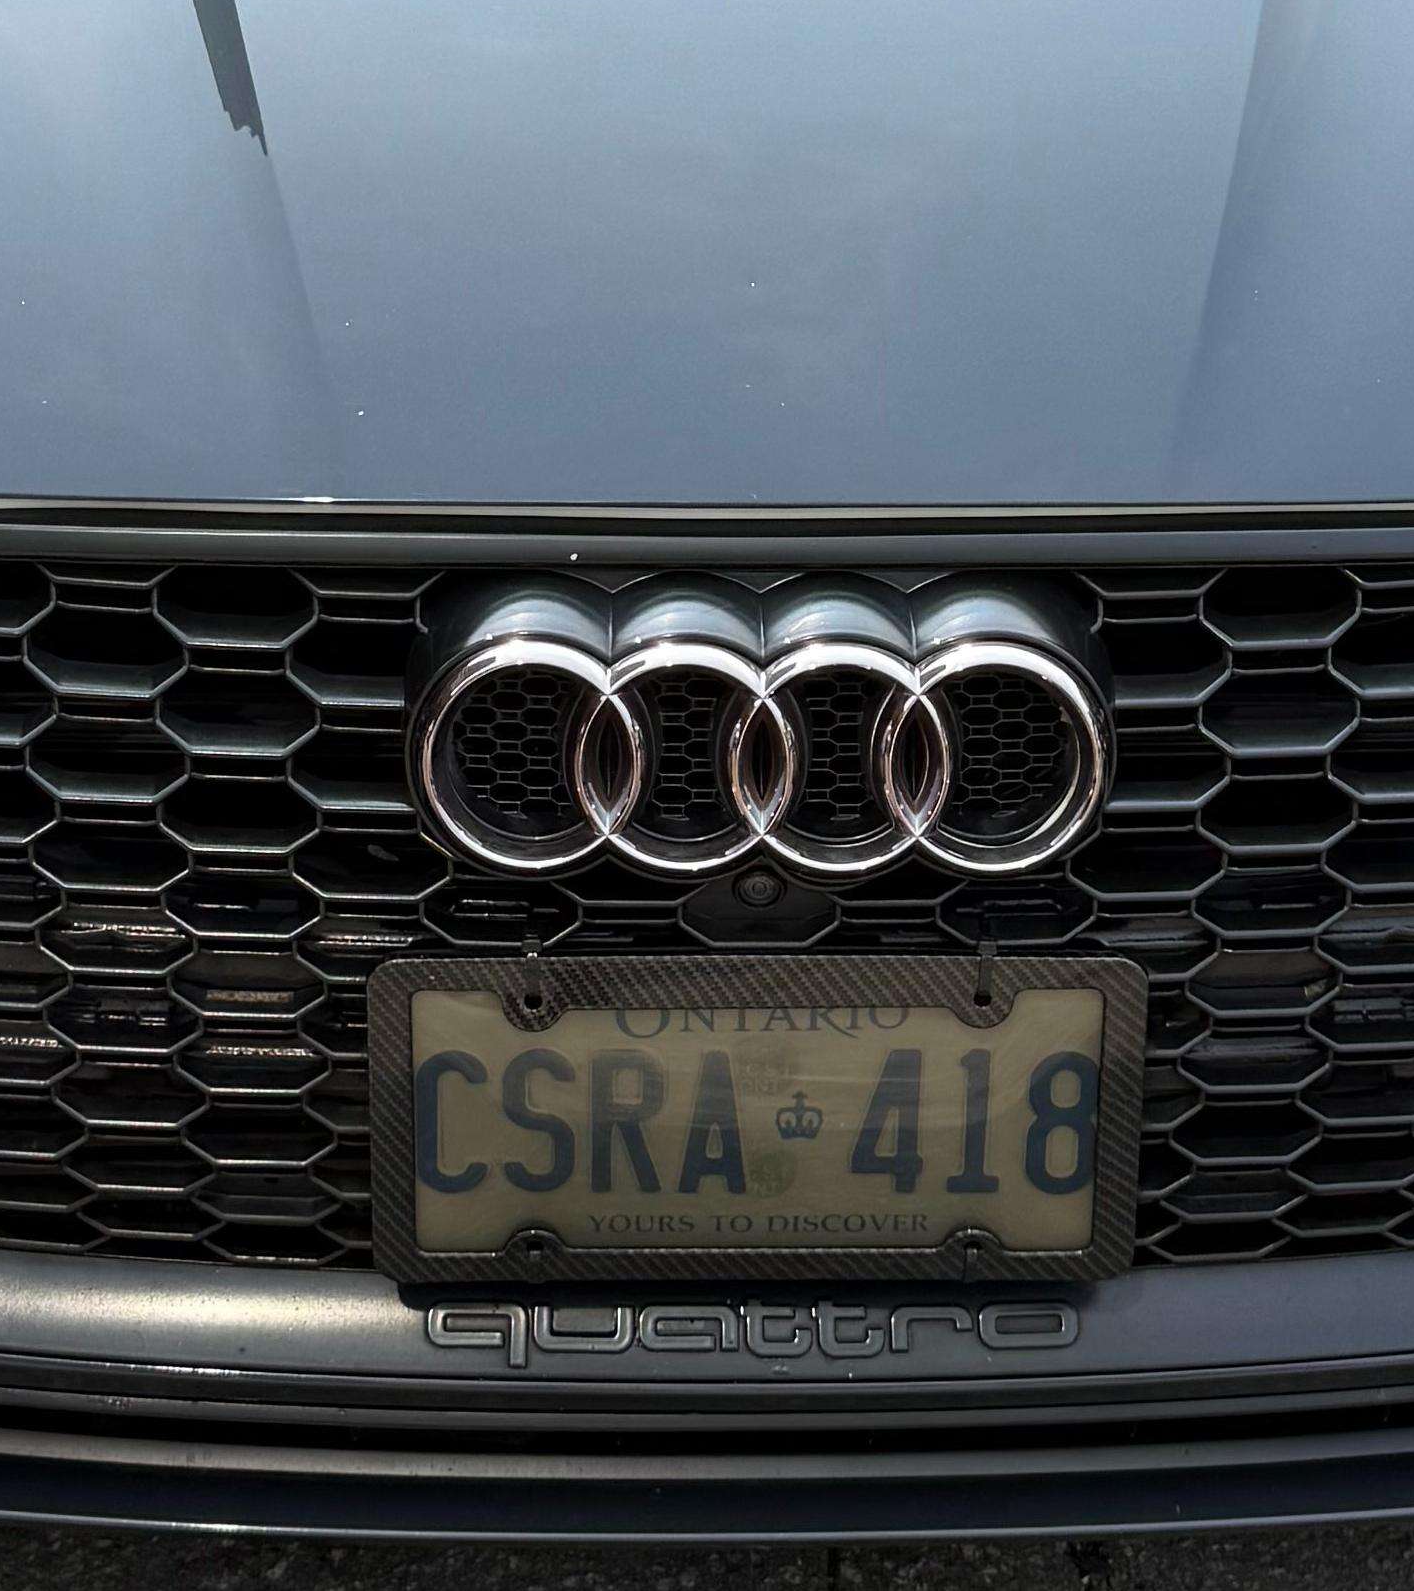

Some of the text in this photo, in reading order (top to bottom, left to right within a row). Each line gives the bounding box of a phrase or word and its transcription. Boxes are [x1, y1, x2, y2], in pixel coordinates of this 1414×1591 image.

[614, 1007, 910, 1040] ONTARIO
[414, 1047, 1099, 1196] CSRA 418
[588, 1212, 929, 1235] YOURS TO DISCOVER
[424, 1298, 1080, 1370] quattro
